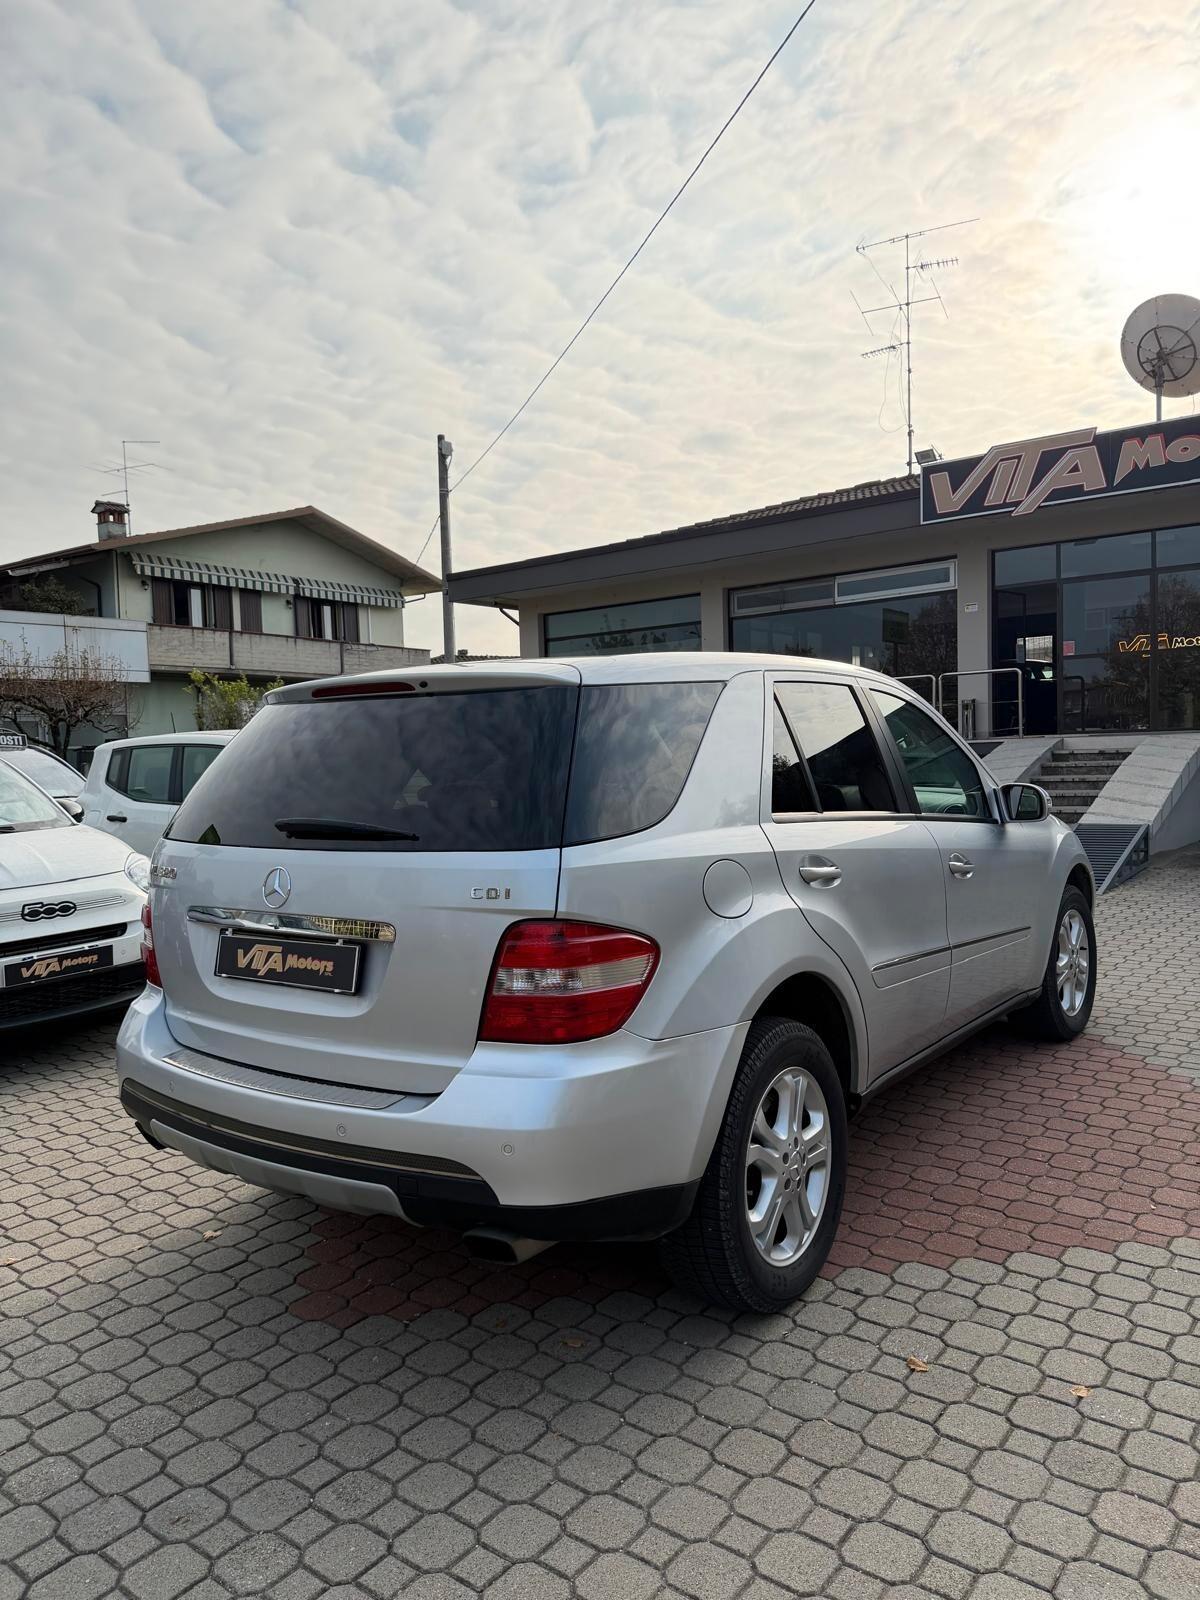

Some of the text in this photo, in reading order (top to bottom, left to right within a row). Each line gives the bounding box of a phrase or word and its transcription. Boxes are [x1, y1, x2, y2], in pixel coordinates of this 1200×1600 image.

[930, 427, 1107, 516] VITA
[471, 887, 511, 899] CDI
[21, 901, 77, 922] 500
[20, 957, 60, 978] VITA
[237, 943, 283, 976] VITA
